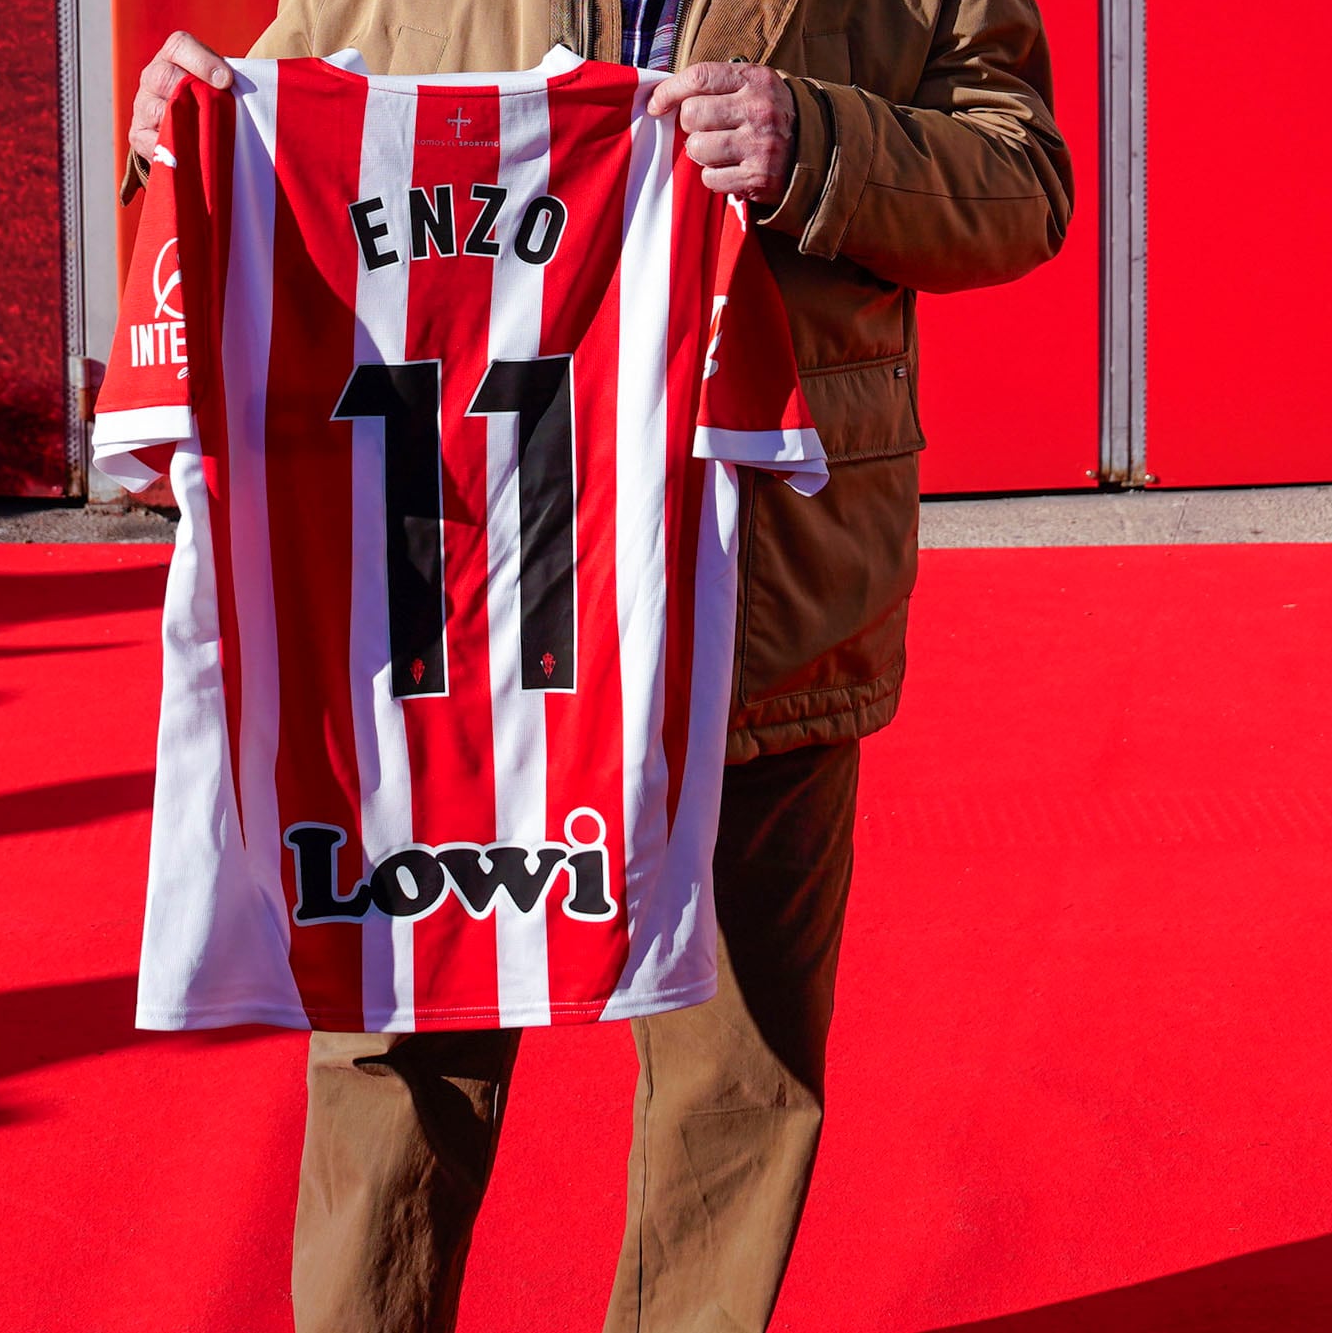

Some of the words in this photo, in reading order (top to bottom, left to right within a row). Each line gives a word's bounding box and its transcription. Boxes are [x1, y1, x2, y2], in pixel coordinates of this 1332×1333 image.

[347, 183, 568, 272] ENZO
[331, 354, 579, 699] 11
[284, 807, 618, 926] Lowi
